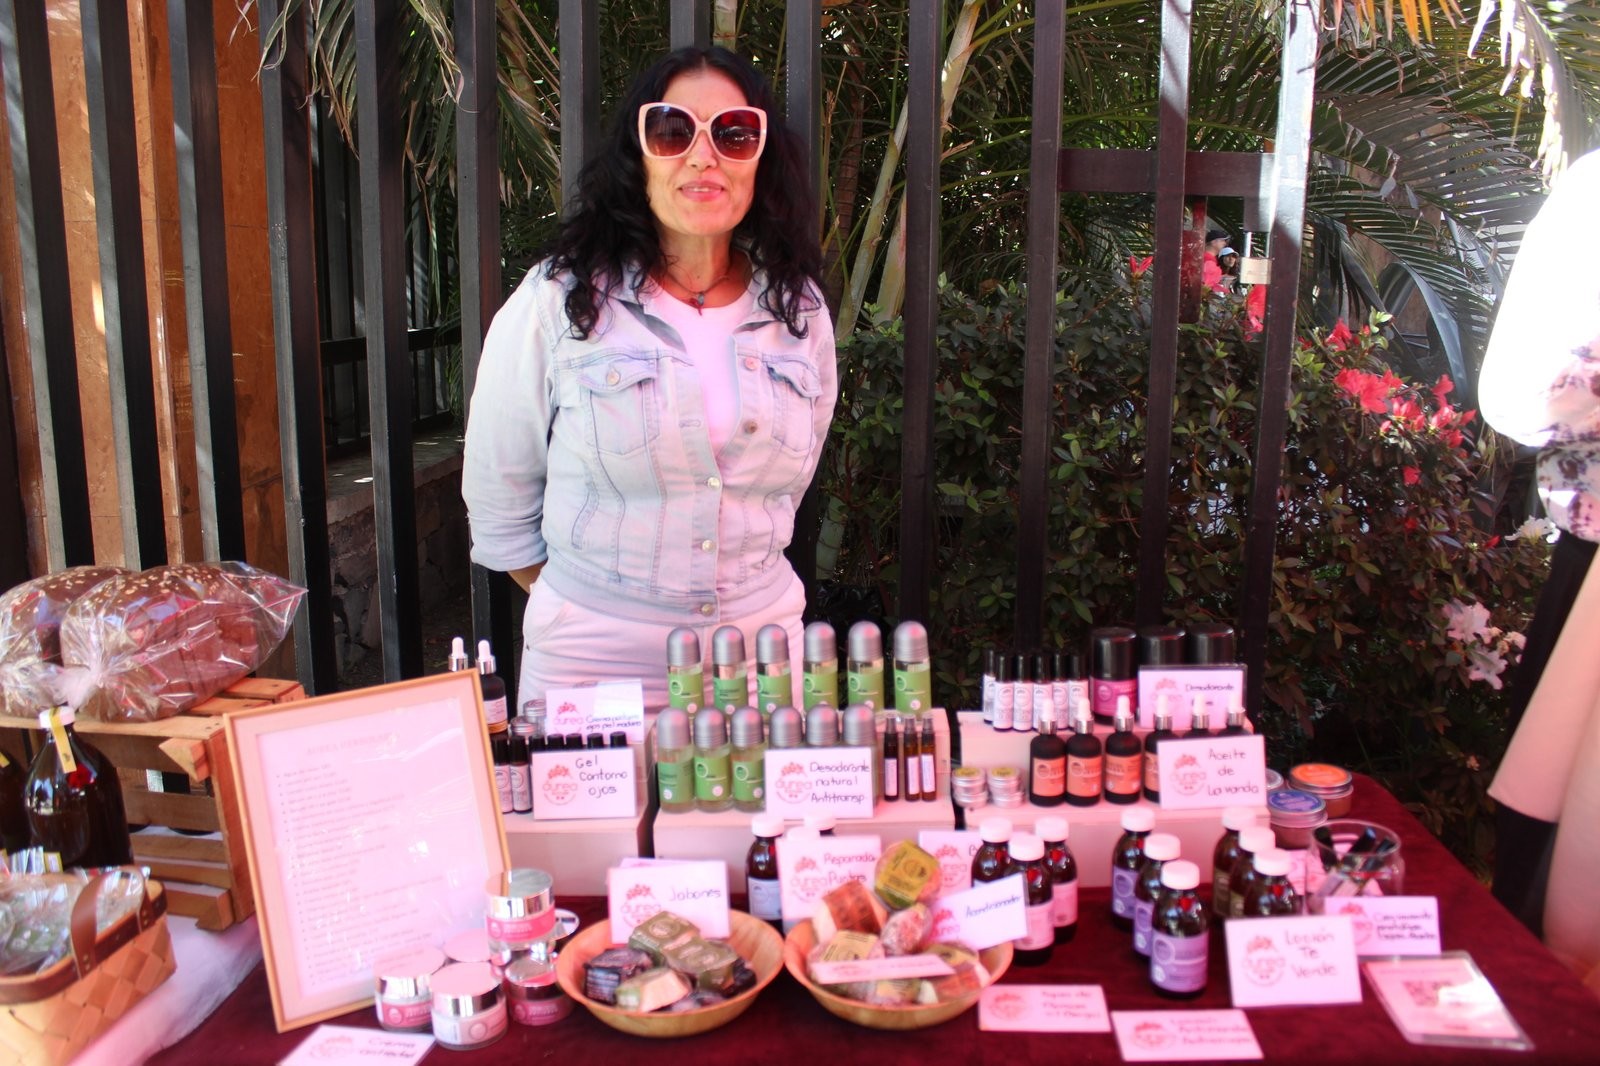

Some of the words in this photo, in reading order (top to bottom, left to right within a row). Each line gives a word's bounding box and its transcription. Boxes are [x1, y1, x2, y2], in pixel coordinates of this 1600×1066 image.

[1208, 747, 1247, 760] Aceite
[575, 754, 598, 769] Gel
[809, 760, 871, 773] Desodorante
[579, 768, 629, 781] Contorno
[1217, 765, 1236, 777] de
[815, 776, 858, 787] natural
[669, 887, 721, 902] Jabones
[1284, 926, 1336, 946] Loción
[1291, 961, 1338, 978] Verde
